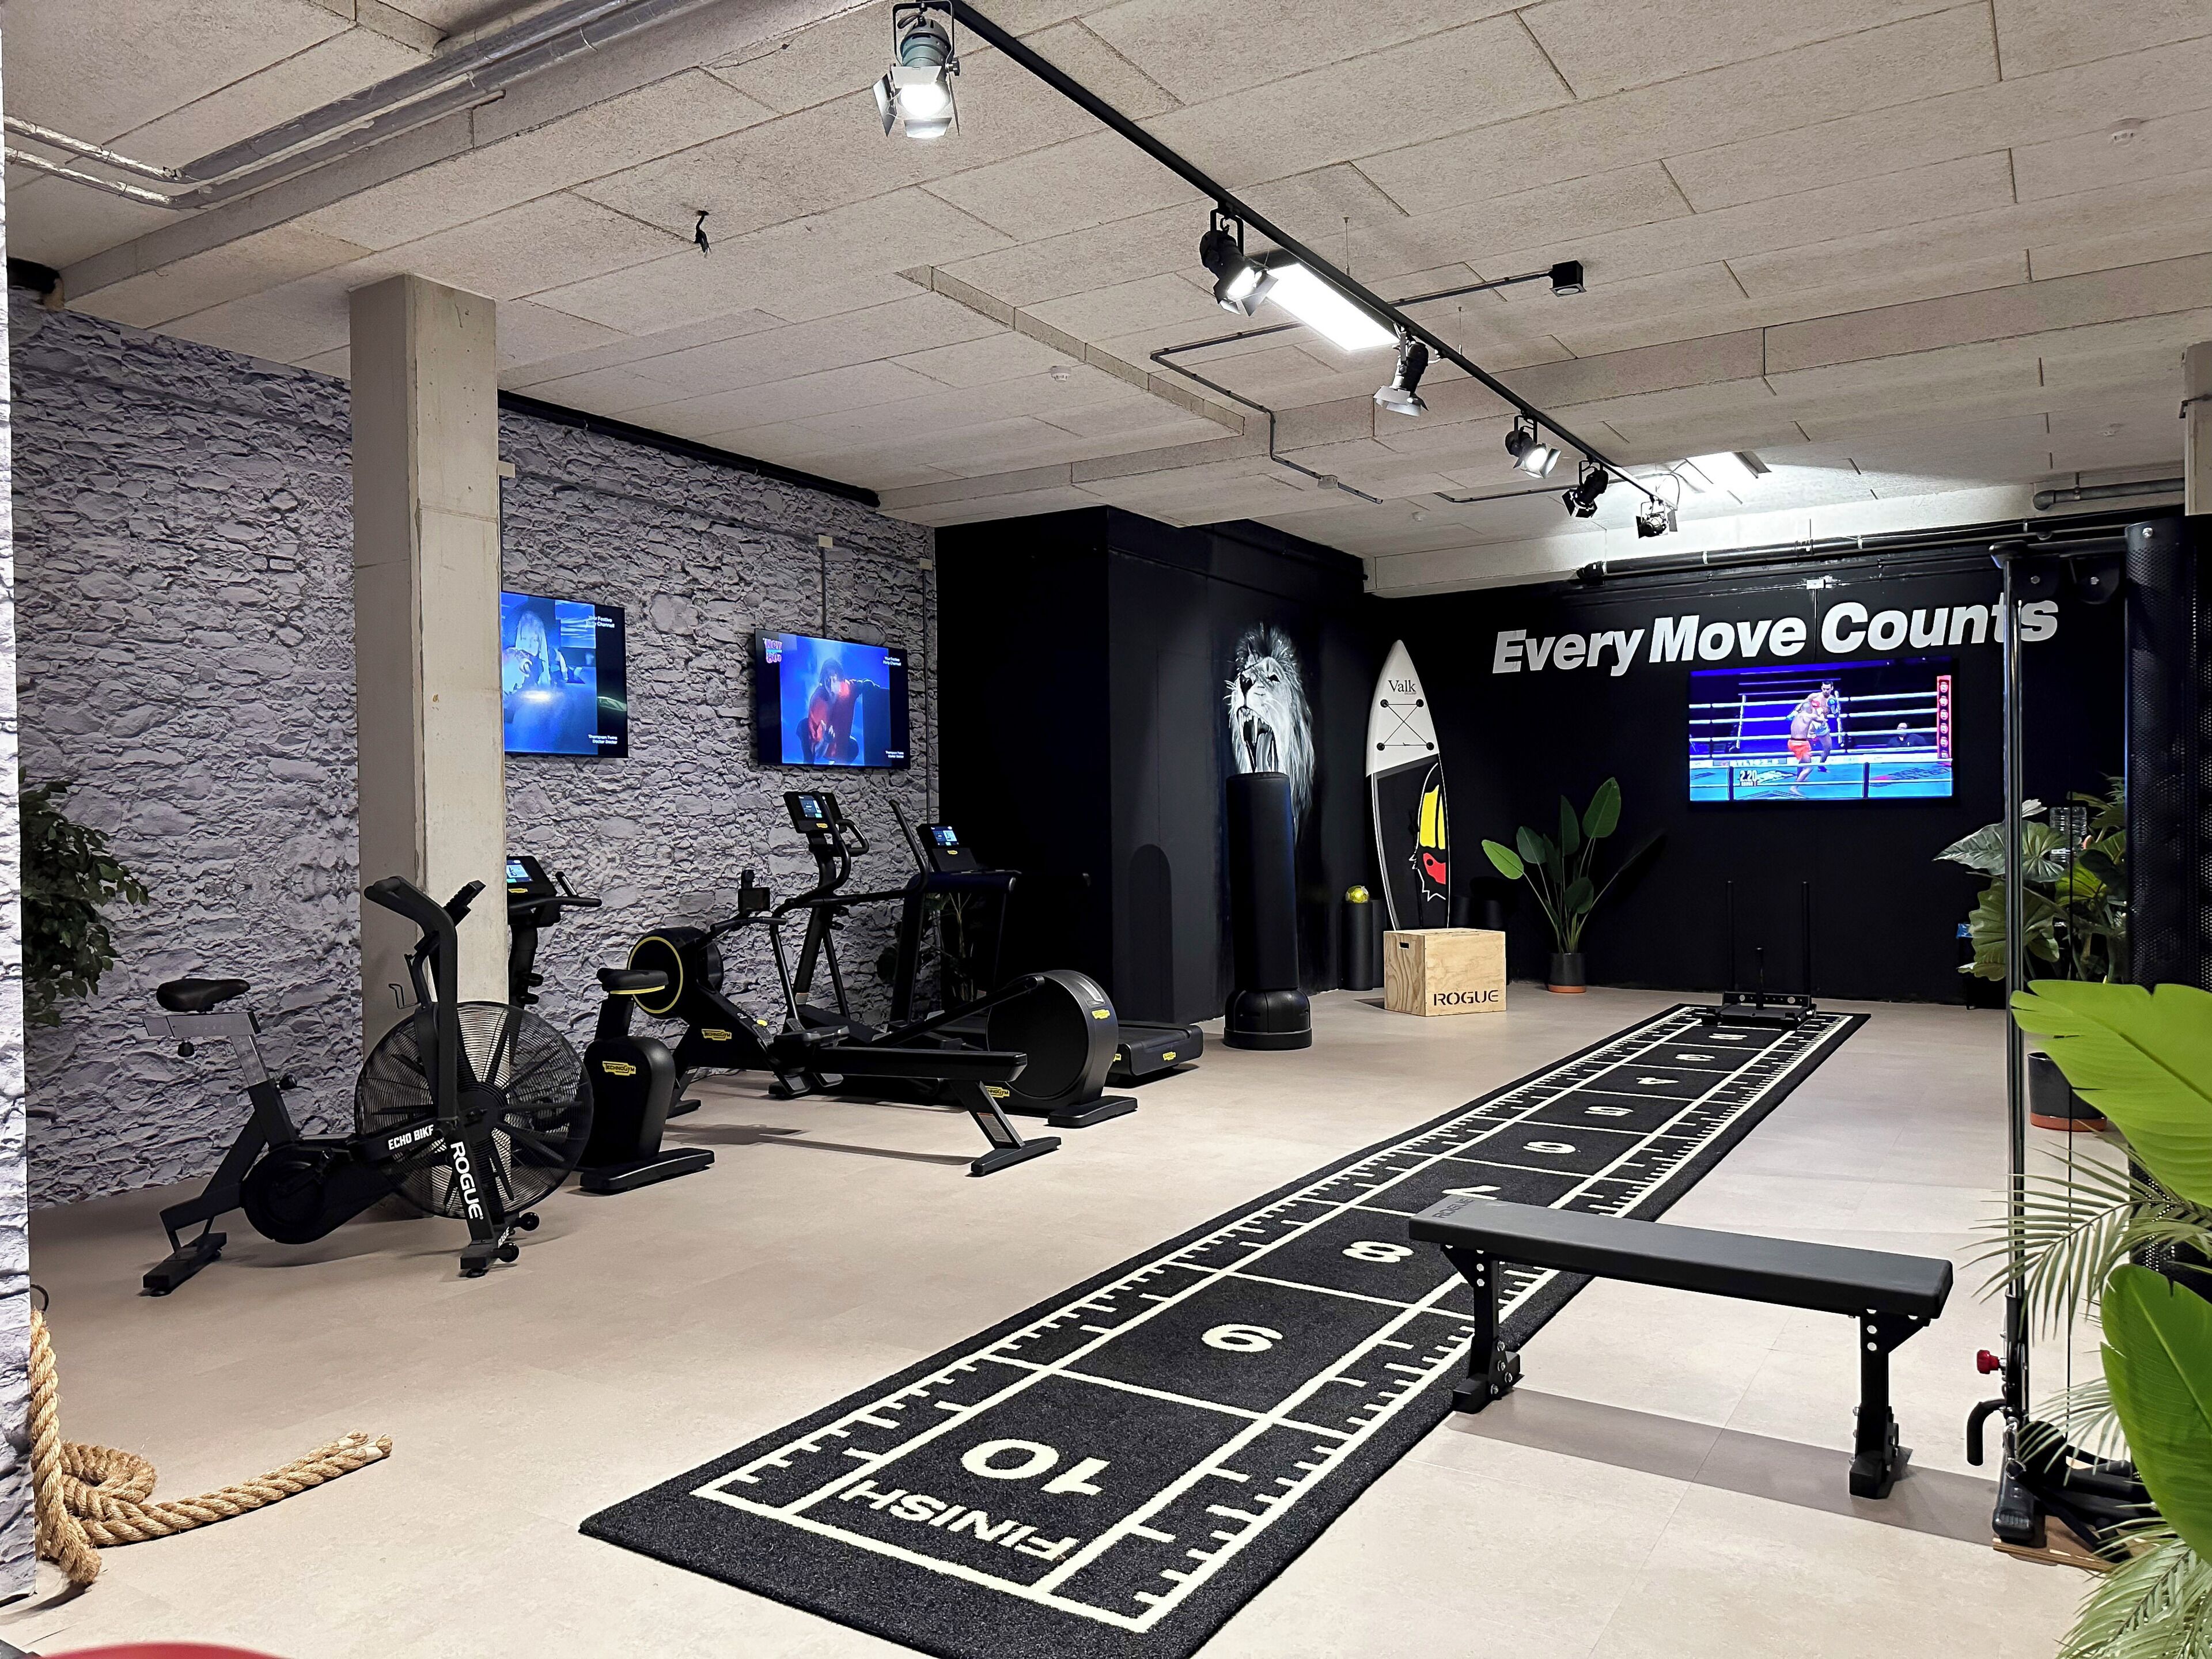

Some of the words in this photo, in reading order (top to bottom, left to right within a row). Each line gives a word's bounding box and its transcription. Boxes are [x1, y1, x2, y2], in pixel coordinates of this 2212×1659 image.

[1493, 629, 1645, 676] Every
[1649, 615, 1806, 663] Move
[1387, 680, 1416, 692] Valk
[1740, 770, 1757, 782] 2.20
[1433, 990, 1499, 1006] ROGUE
[1636, 1077, 1679, 1085] 4
[1584, 1106, 1634, 1116] 5
[388, 1132, 412, 1150] ECHO
[1523, 1141, 1576, 1154] 6
[1432, 1198, 1474, 1218] ROGUE
[1342, 1241, 1413, 1262] 8
[1201, 1323, 1283, 1352] 9
[961, 1439, 1111, 1496] 10
[838, 1480, 1080, 1562] FINISH
